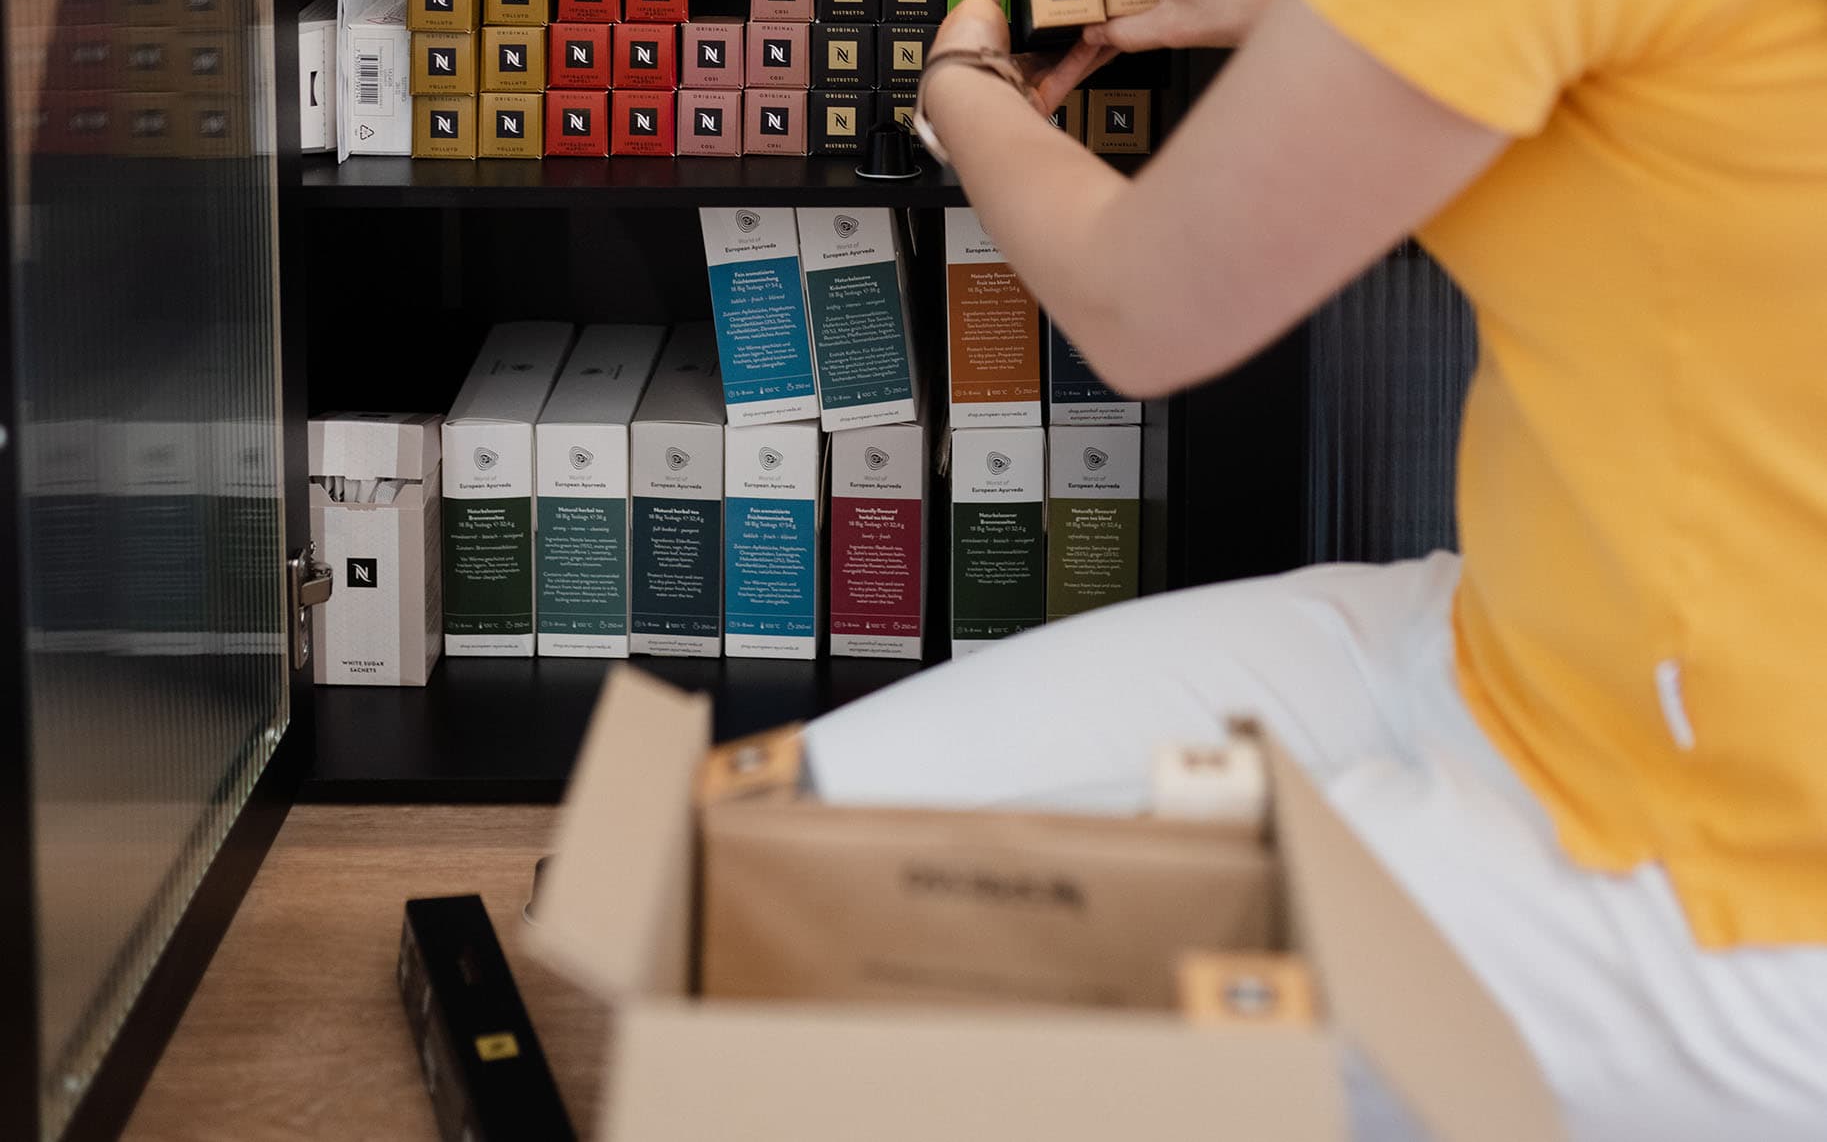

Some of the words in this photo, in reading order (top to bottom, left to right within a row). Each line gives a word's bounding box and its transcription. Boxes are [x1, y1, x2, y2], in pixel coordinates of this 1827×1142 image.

[433, 52, 452, 71] N
[503, 49, 523, 67] N
[571, 45, 589, 64] N
[635, 46, 653, 65] N
[702, 45, 720, 63] N
[768, 44, 787, 63] N
[835, 47, 851, 64] N
[900, 47, 916, 64] N
[435, 115, 454, 134] N
[501, 115, 520, 134] N
[567, 112, 586, 131] N
[634, 112, 653, 131] N
[699, 113, 718, 132] N
[765, 112, 784, 130] N
[833, 112, 849, 130] N
[1111, 110, 1128, 128] N
[725, 245, 750, 253] European
[752, 243, 776, 251] Ayurveda
[850, 248, 875, 256] Ayurveda
[352, 563, 372, 583] N
